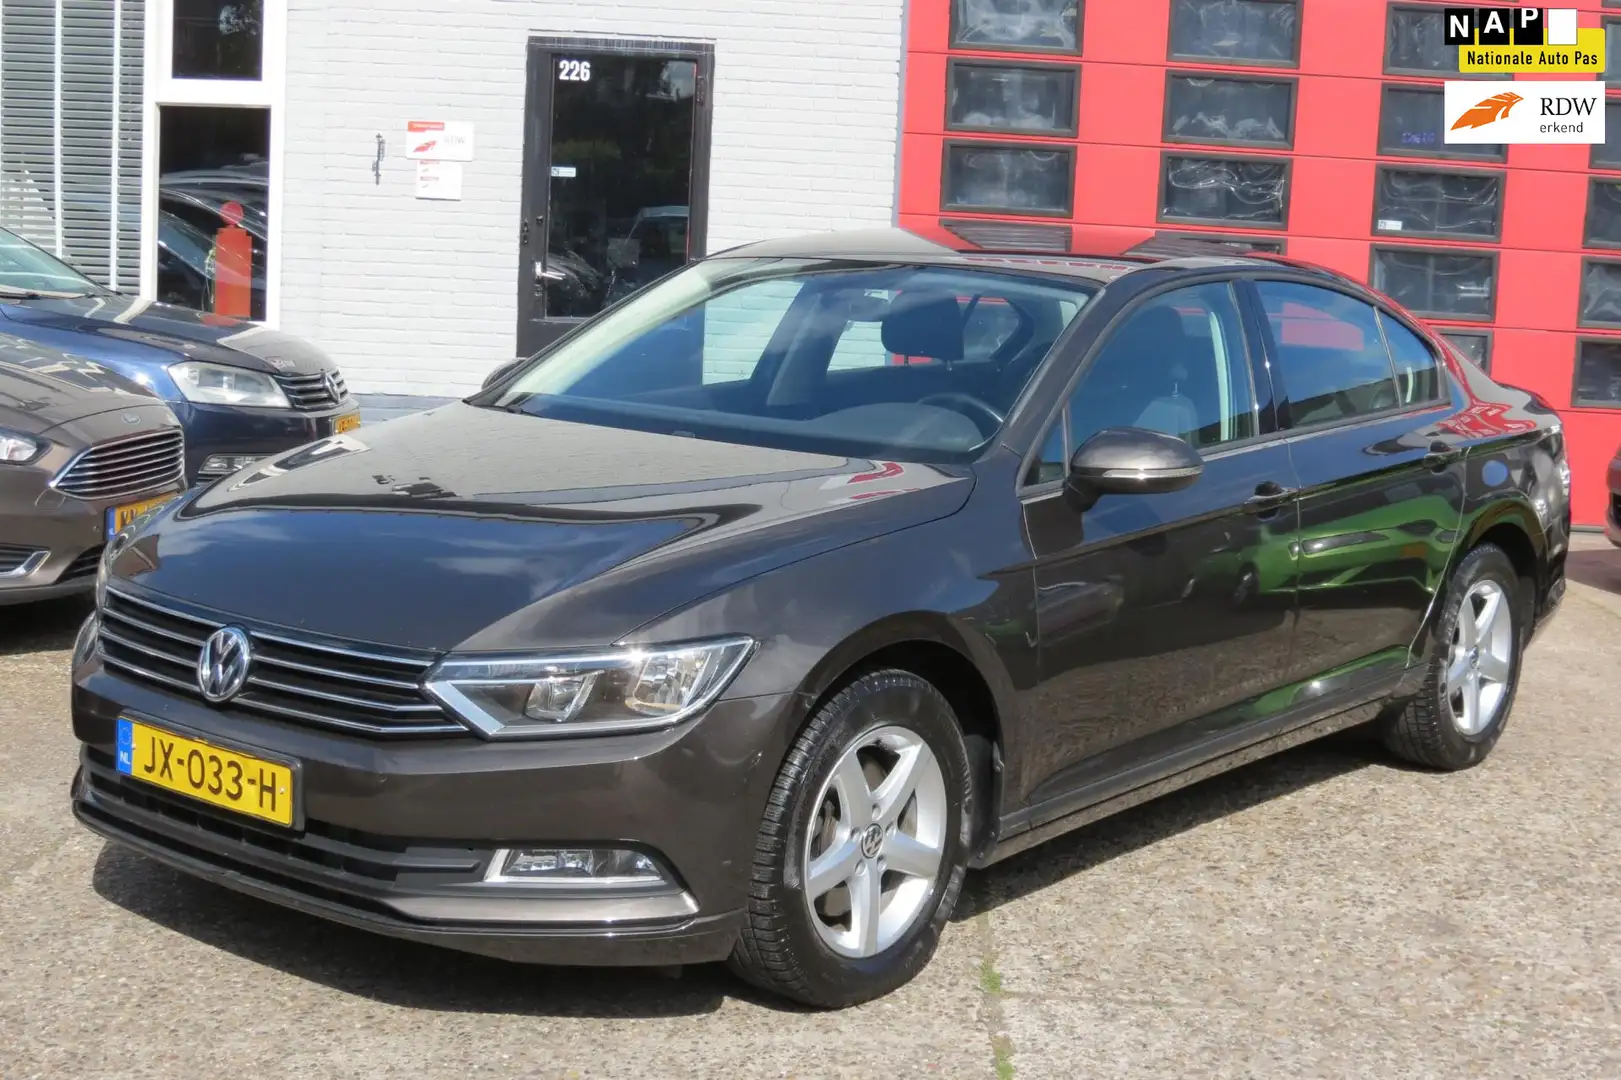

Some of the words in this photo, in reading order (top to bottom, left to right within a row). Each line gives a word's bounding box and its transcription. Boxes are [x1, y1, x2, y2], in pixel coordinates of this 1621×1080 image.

[558, 59, 591, 82] 226
[120, 750, 131, 765] NL
[143, 736, 277, 812] JX-033-H
